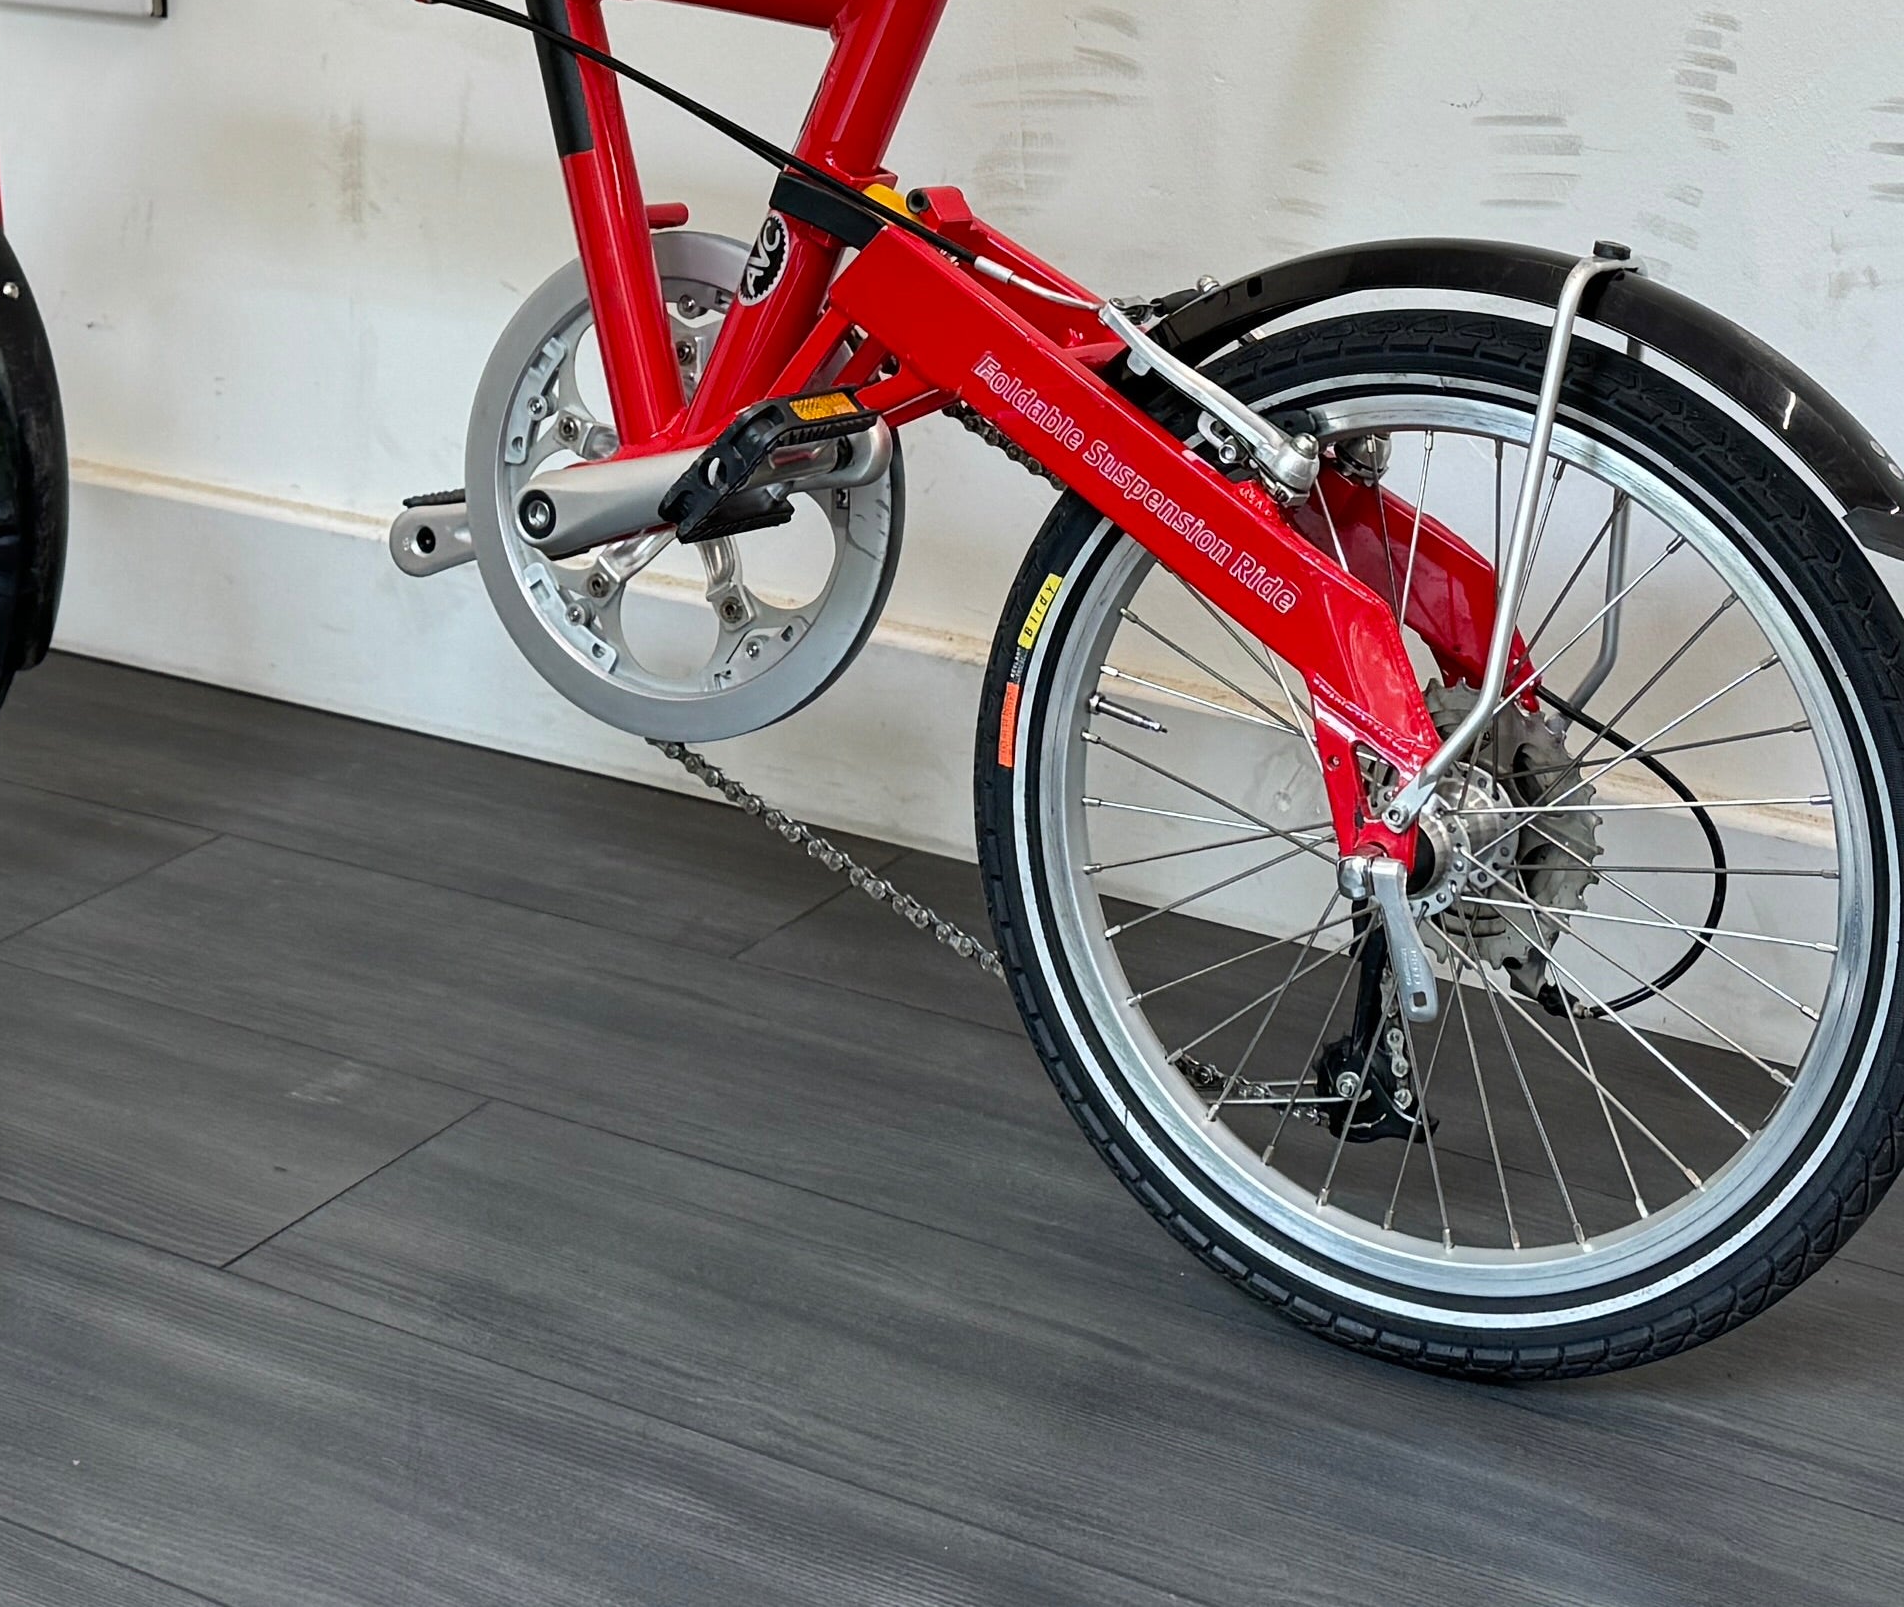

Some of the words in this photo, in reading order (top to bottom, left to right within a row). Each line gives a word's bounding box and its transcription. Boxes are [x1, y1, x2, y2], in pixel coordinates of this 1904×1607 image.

[746, 219, 781, 296] AVC
[973, 350, 1085, 452] Foldable
[1082, 439, 1233, 568] Suspension
[1230, 550, 1297, 616] Ride
